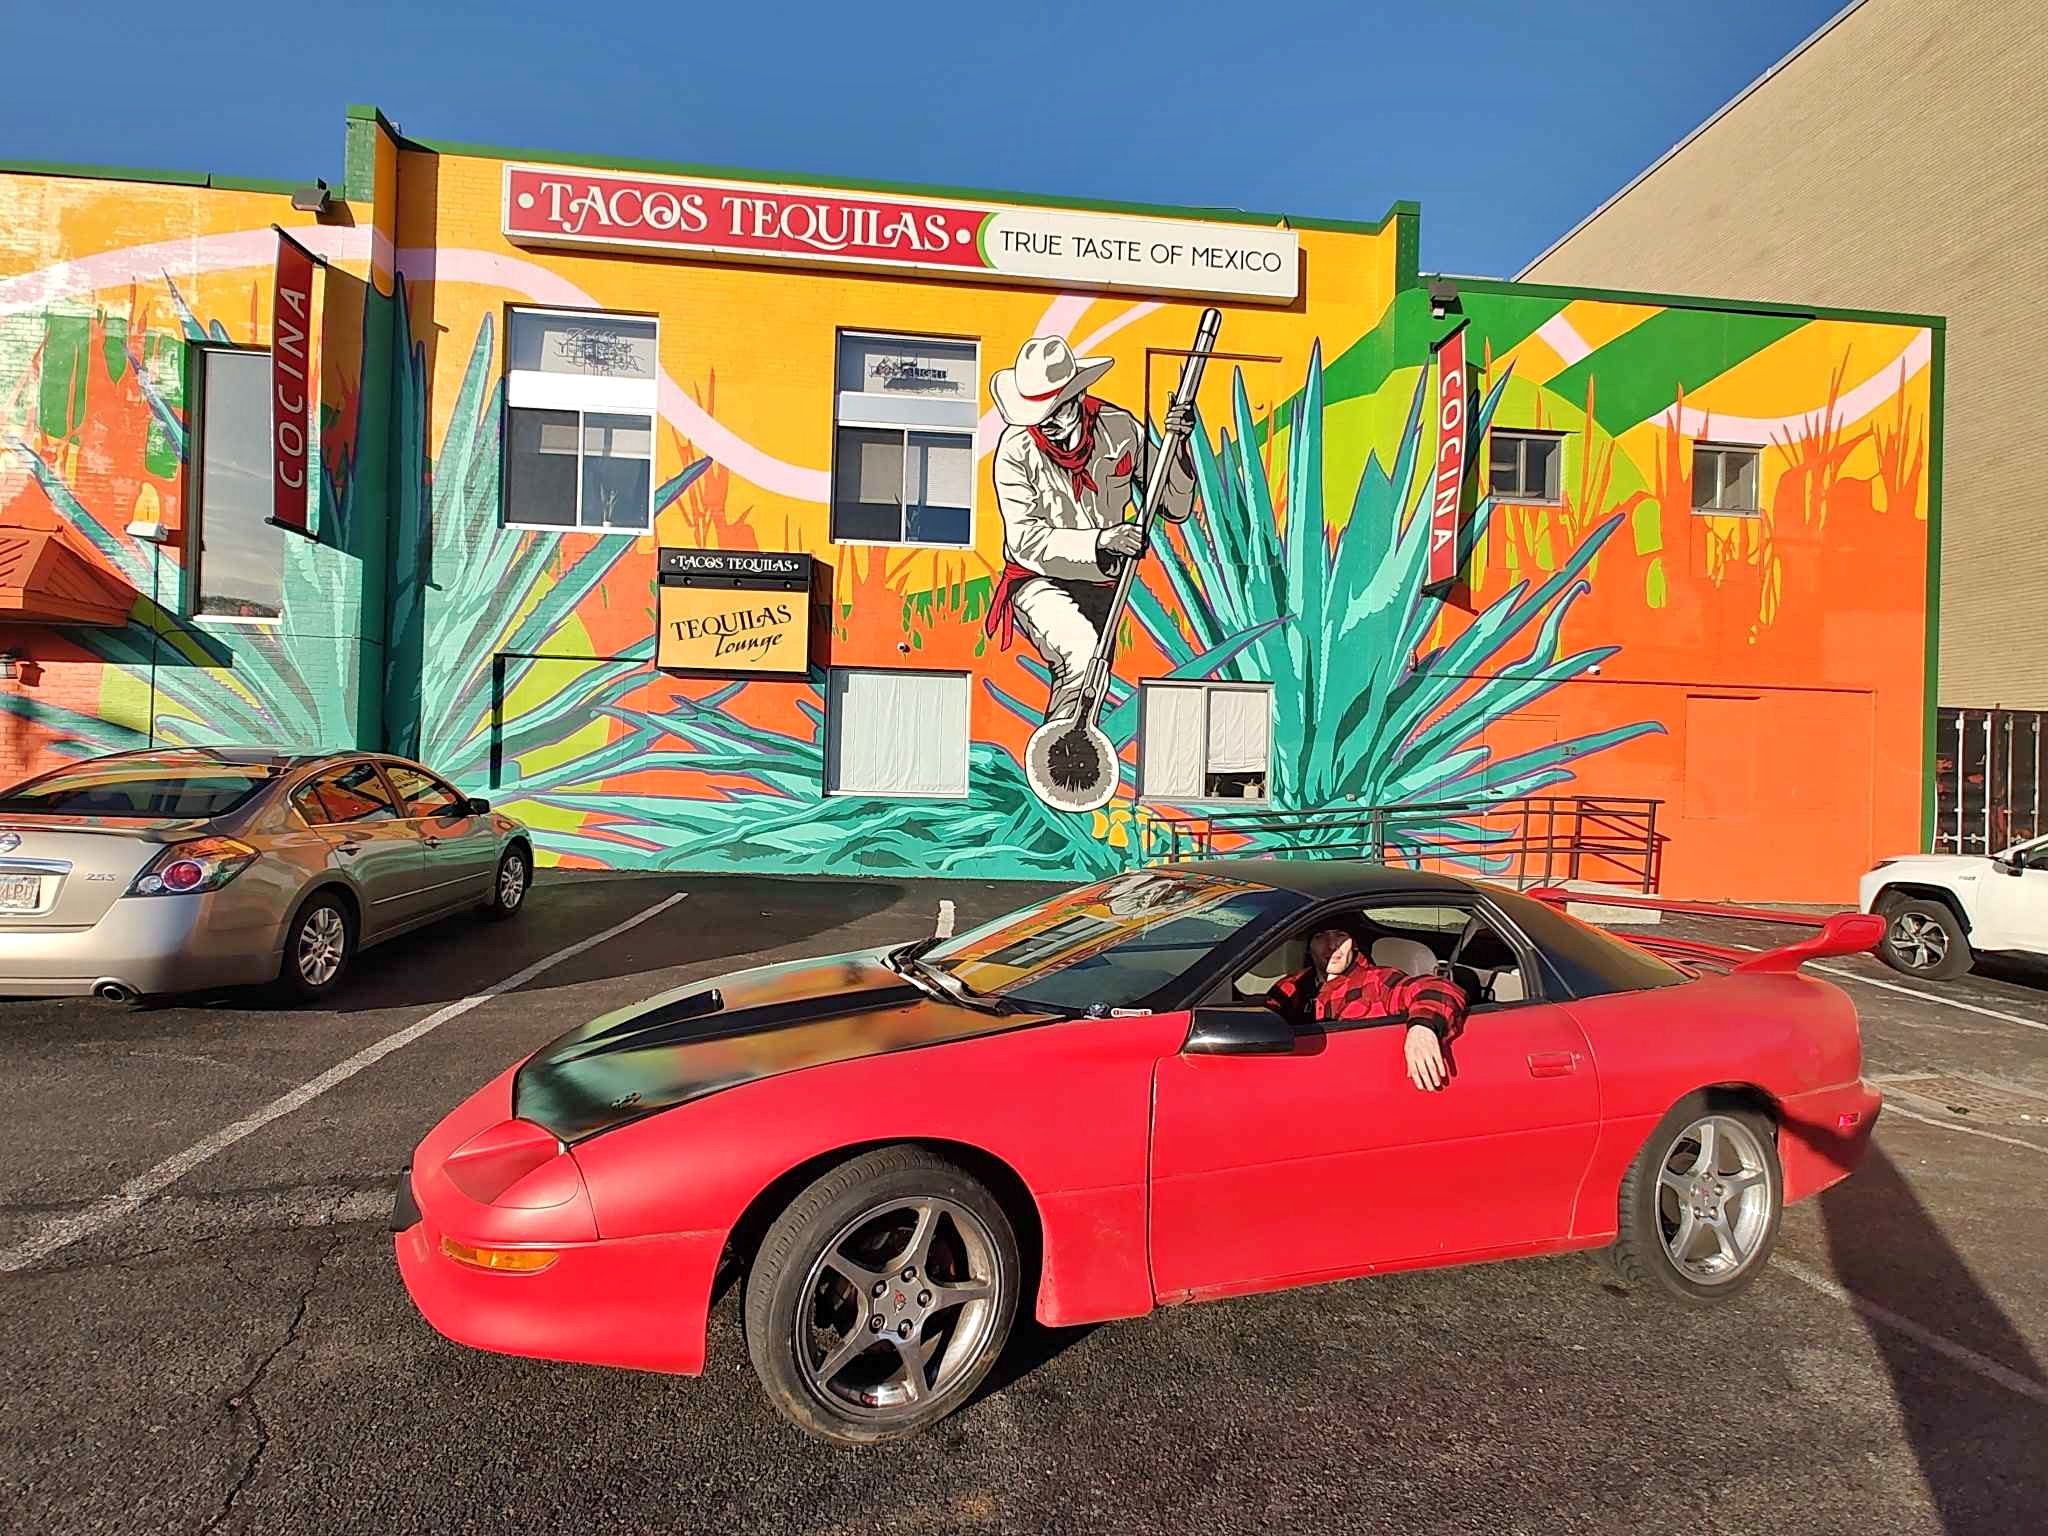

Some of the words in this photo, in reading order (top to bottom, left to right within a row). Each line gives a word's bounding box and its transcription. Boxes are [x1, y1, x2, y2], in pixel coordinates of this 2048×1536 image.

[540, 182, 707, 233] TACOS
[722, 196, 950, 251] TEQUILAS
[1000, 231, 1062, 256] TRUE
[1072, 237, 1141, 263] TASTE
[1150, 244, 1183, 265] OF
[1192, 247, 1282, 273] MEXICO
[278, 287, 306, 489] COCINA
[1434, 371, 1461, 551] COCINA
[677, 555, 723, 570] TACOS
[727, 558, 793, 573] TEQUILAS
[670, 604, 792, 642] TEQUILAS
[715, 633, 783, 662] Lounge
